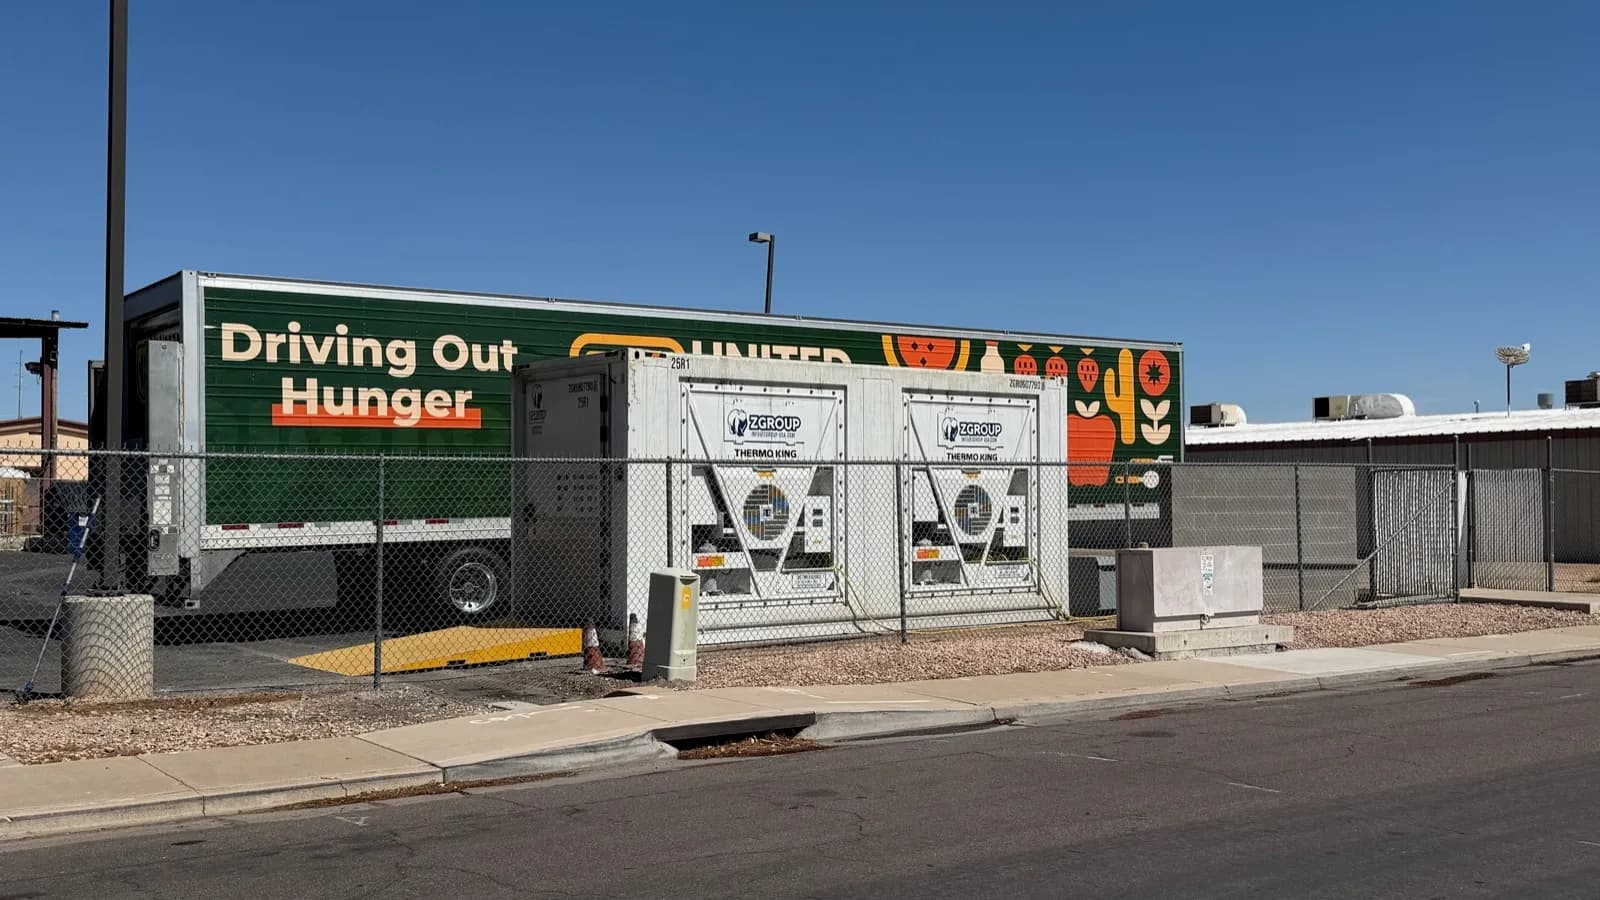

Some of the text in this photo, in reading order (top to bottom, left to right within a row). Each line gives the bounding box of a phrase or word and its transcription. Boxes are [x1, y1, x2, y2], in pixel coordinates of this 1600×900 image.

[221, 321, 518, 378] Driving Out
[671, 357, 690, 370] 25R1
[281, 377, 473, 427] Hunger
[749, 414, 801, 432] ZGROUP
[959, 421, 1002, 437] ZGROUP
[735, 448, 797, 459] THERMO KING
[947, 452, 998, 461] THERMO KING
